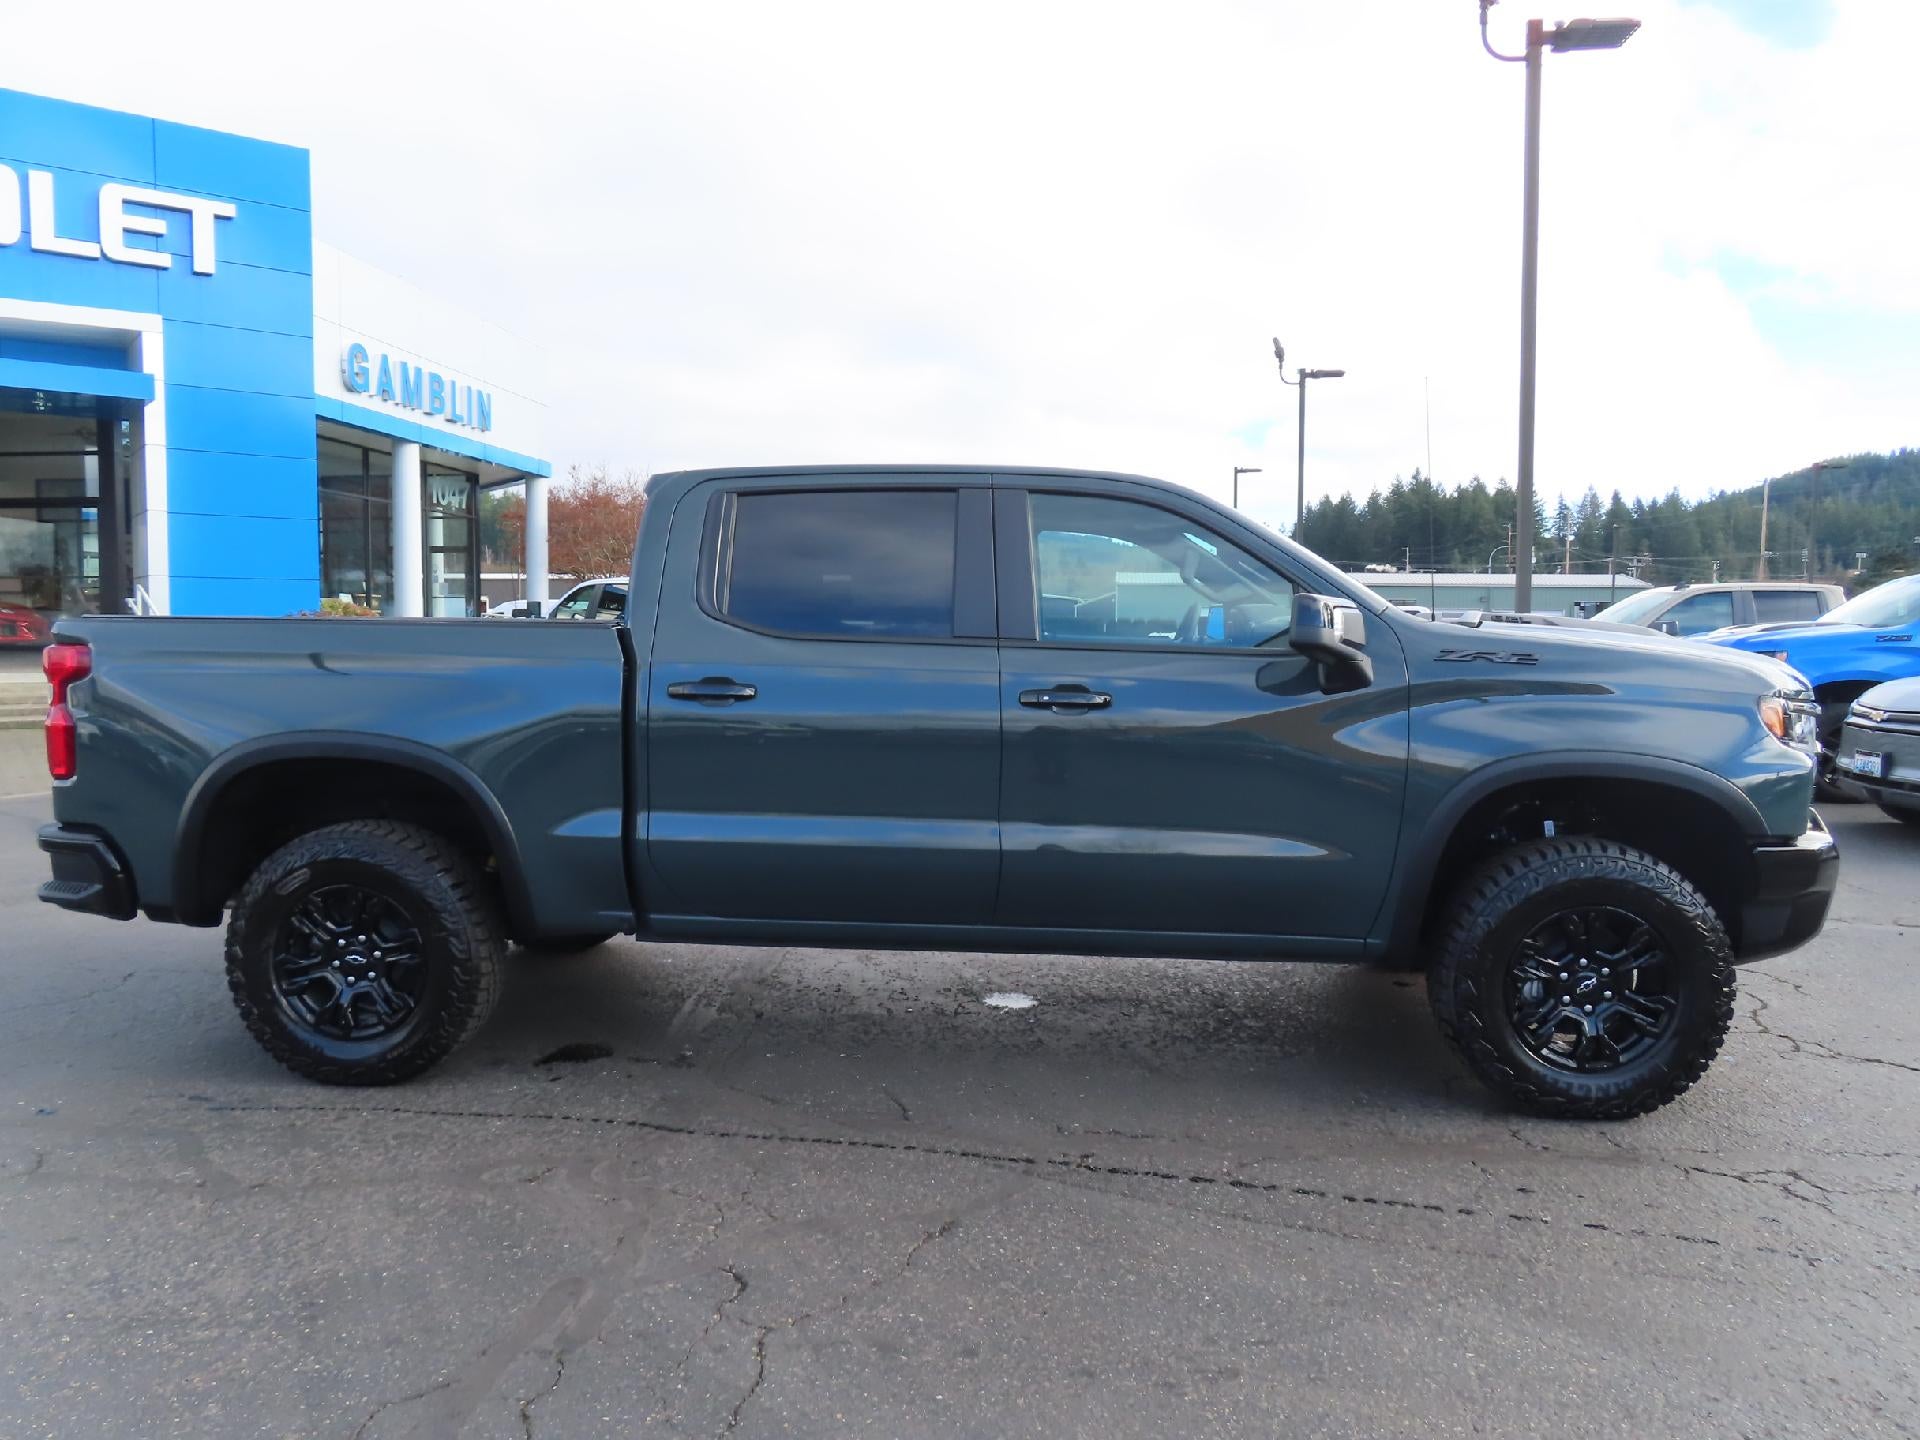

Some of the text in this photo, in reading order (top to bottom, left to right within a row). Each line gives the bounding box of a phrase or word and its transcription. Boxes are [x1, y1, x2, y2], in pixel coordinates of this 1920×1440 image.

[342, 343, 491, 431] GAMBLIN
[431, 481, 469, 509] 1047
[1433, 650, 1539, 665] ZR2
